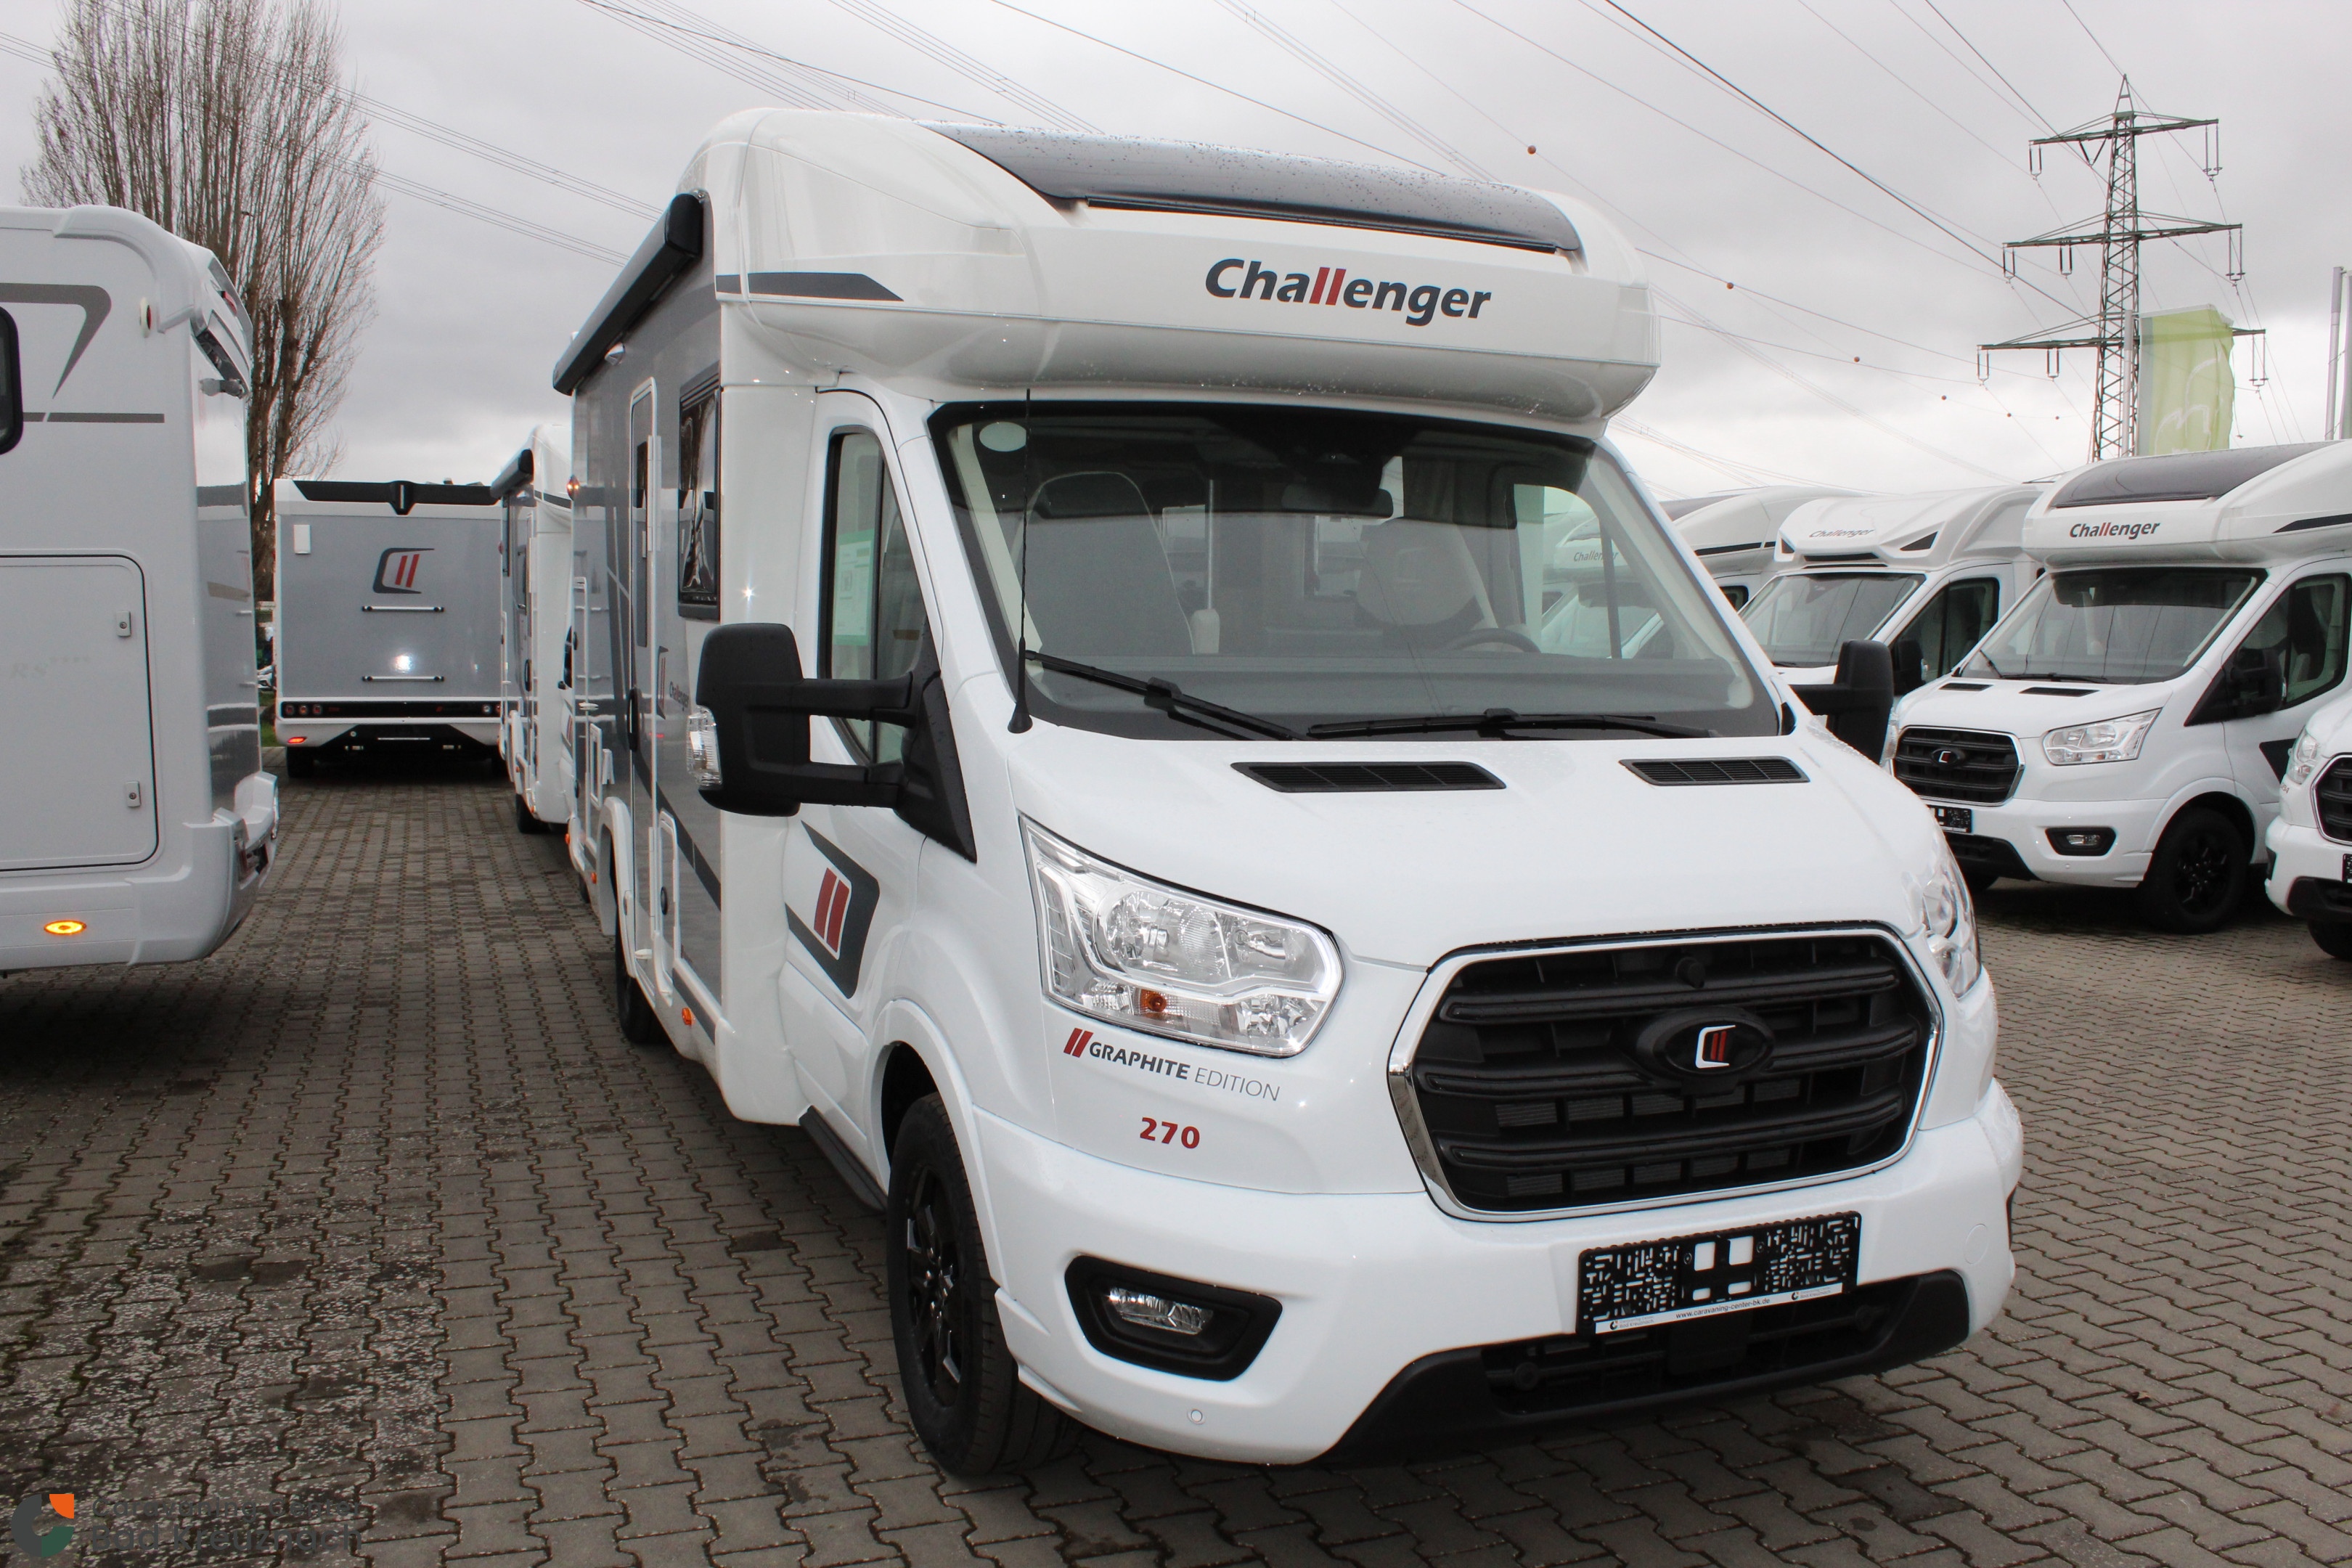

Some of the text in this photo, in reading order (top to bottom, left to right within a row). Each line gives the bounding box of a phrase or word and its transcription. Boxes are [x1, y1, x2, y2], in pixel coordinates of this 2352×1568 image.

[1205, 258, 1491, 327] Challenger
[1809, 529, 1874, 538] Challenger
[2070, 522, 2161, 539] Challenger
[1089, 1041, 1281, 1101] GRAPHITE EDITION
[1140, 1116, 1201, 1149] 270
[1675, 1297, 1770, 1319] www.caravaning-center-bk.de
